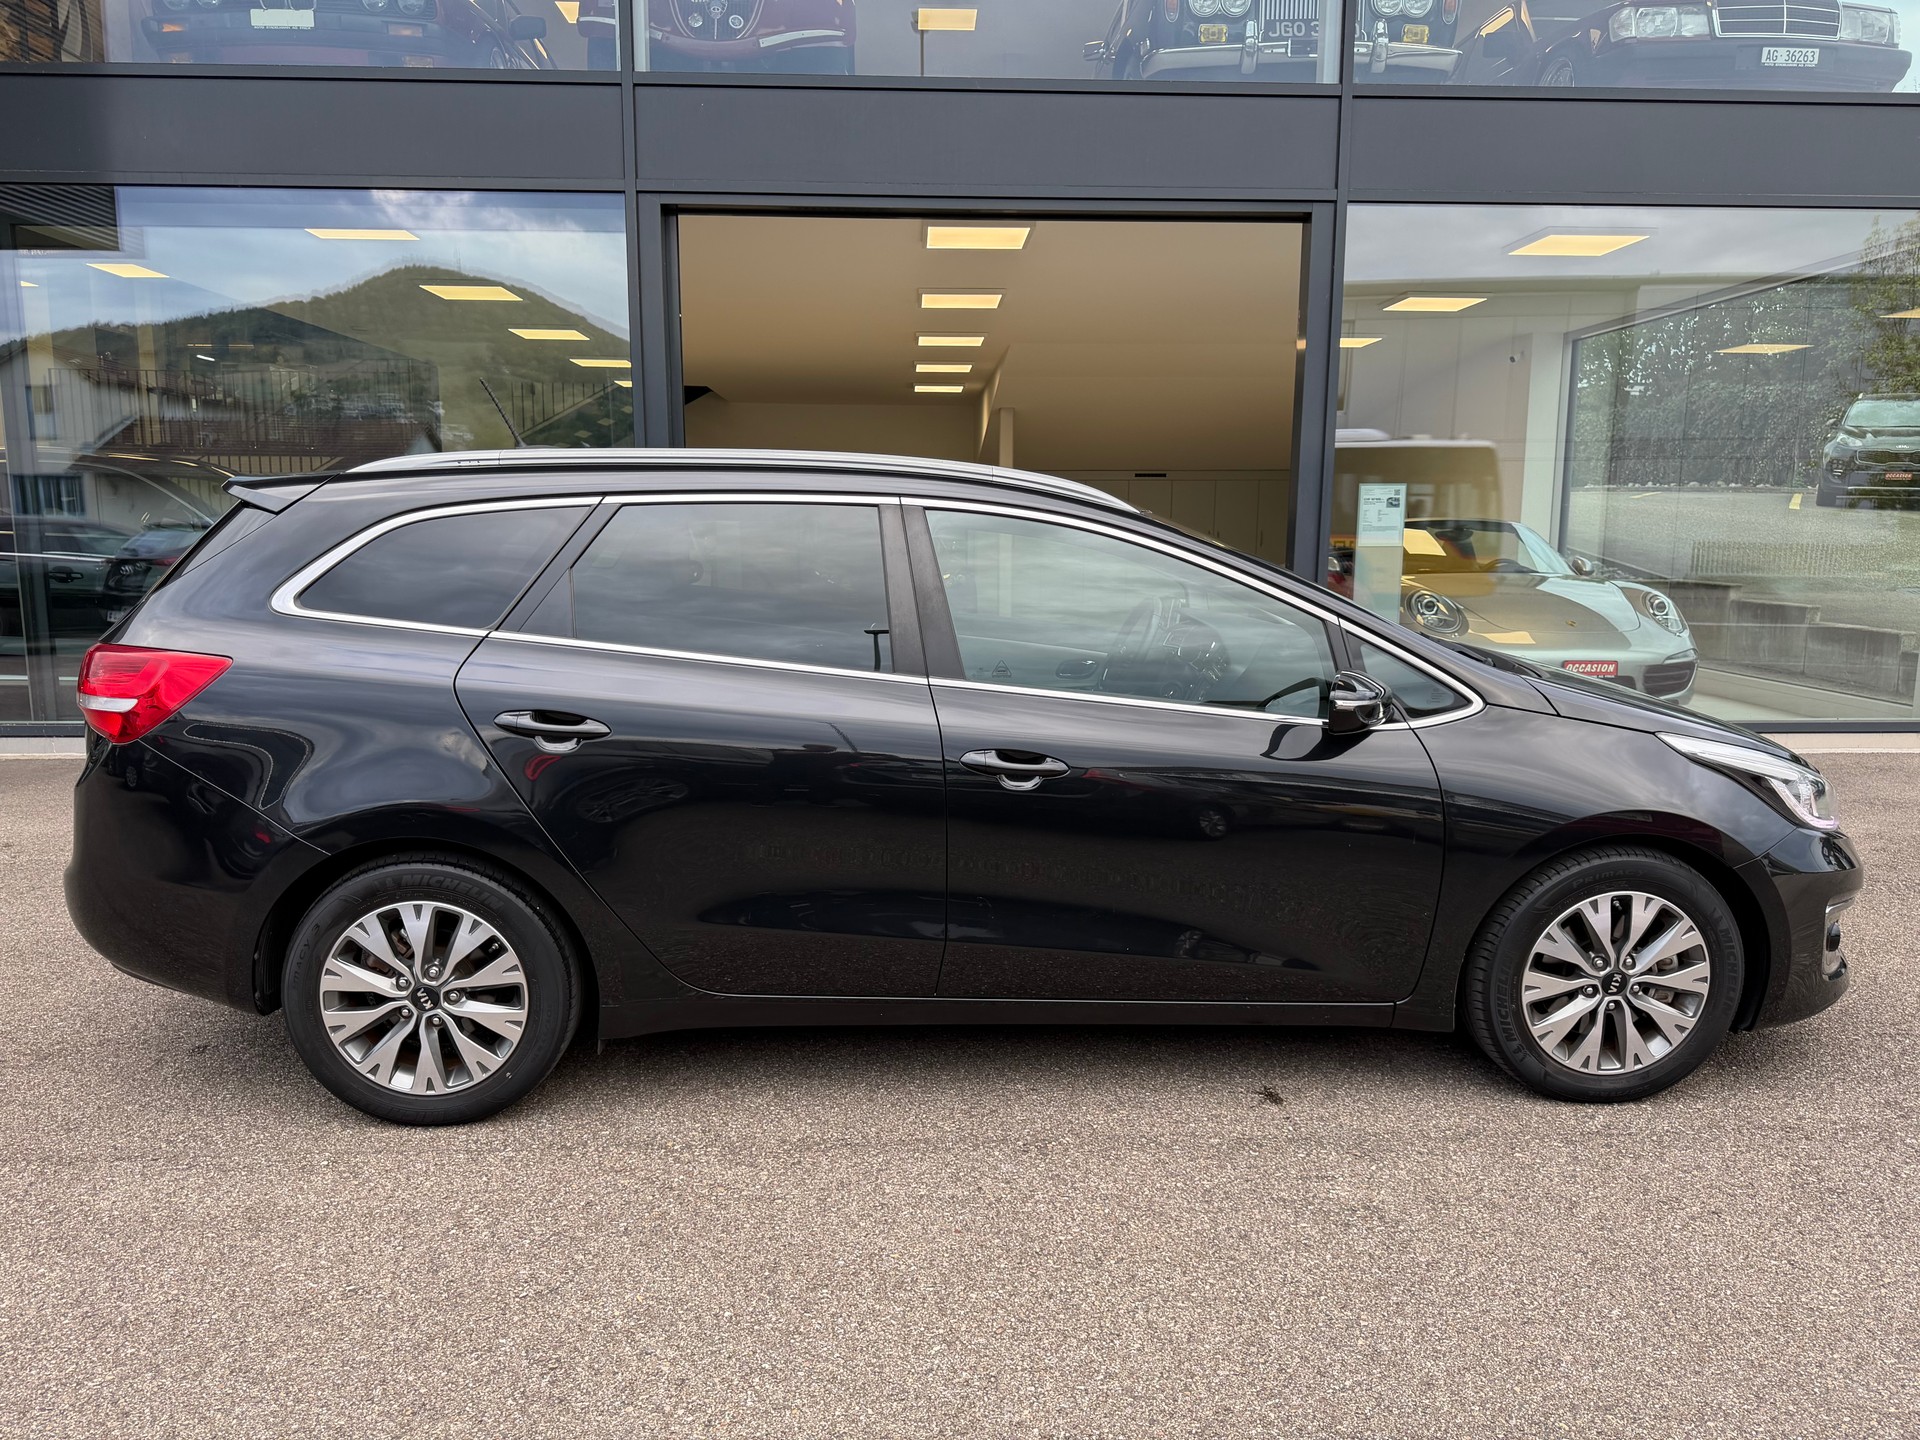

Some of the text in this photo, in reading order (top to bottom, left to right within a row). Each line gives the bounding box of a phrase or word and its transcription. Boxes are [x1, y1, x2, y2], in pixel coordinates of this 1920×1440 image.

[1269, 22, 1305, 37] JGO
[1566, 663, 1615, 672] OCCASION
[400, 874, 505, 910] MICHELIN
[1607, 973, 1622, 993] KIA
[416, 987, 433, 1010] KIA
